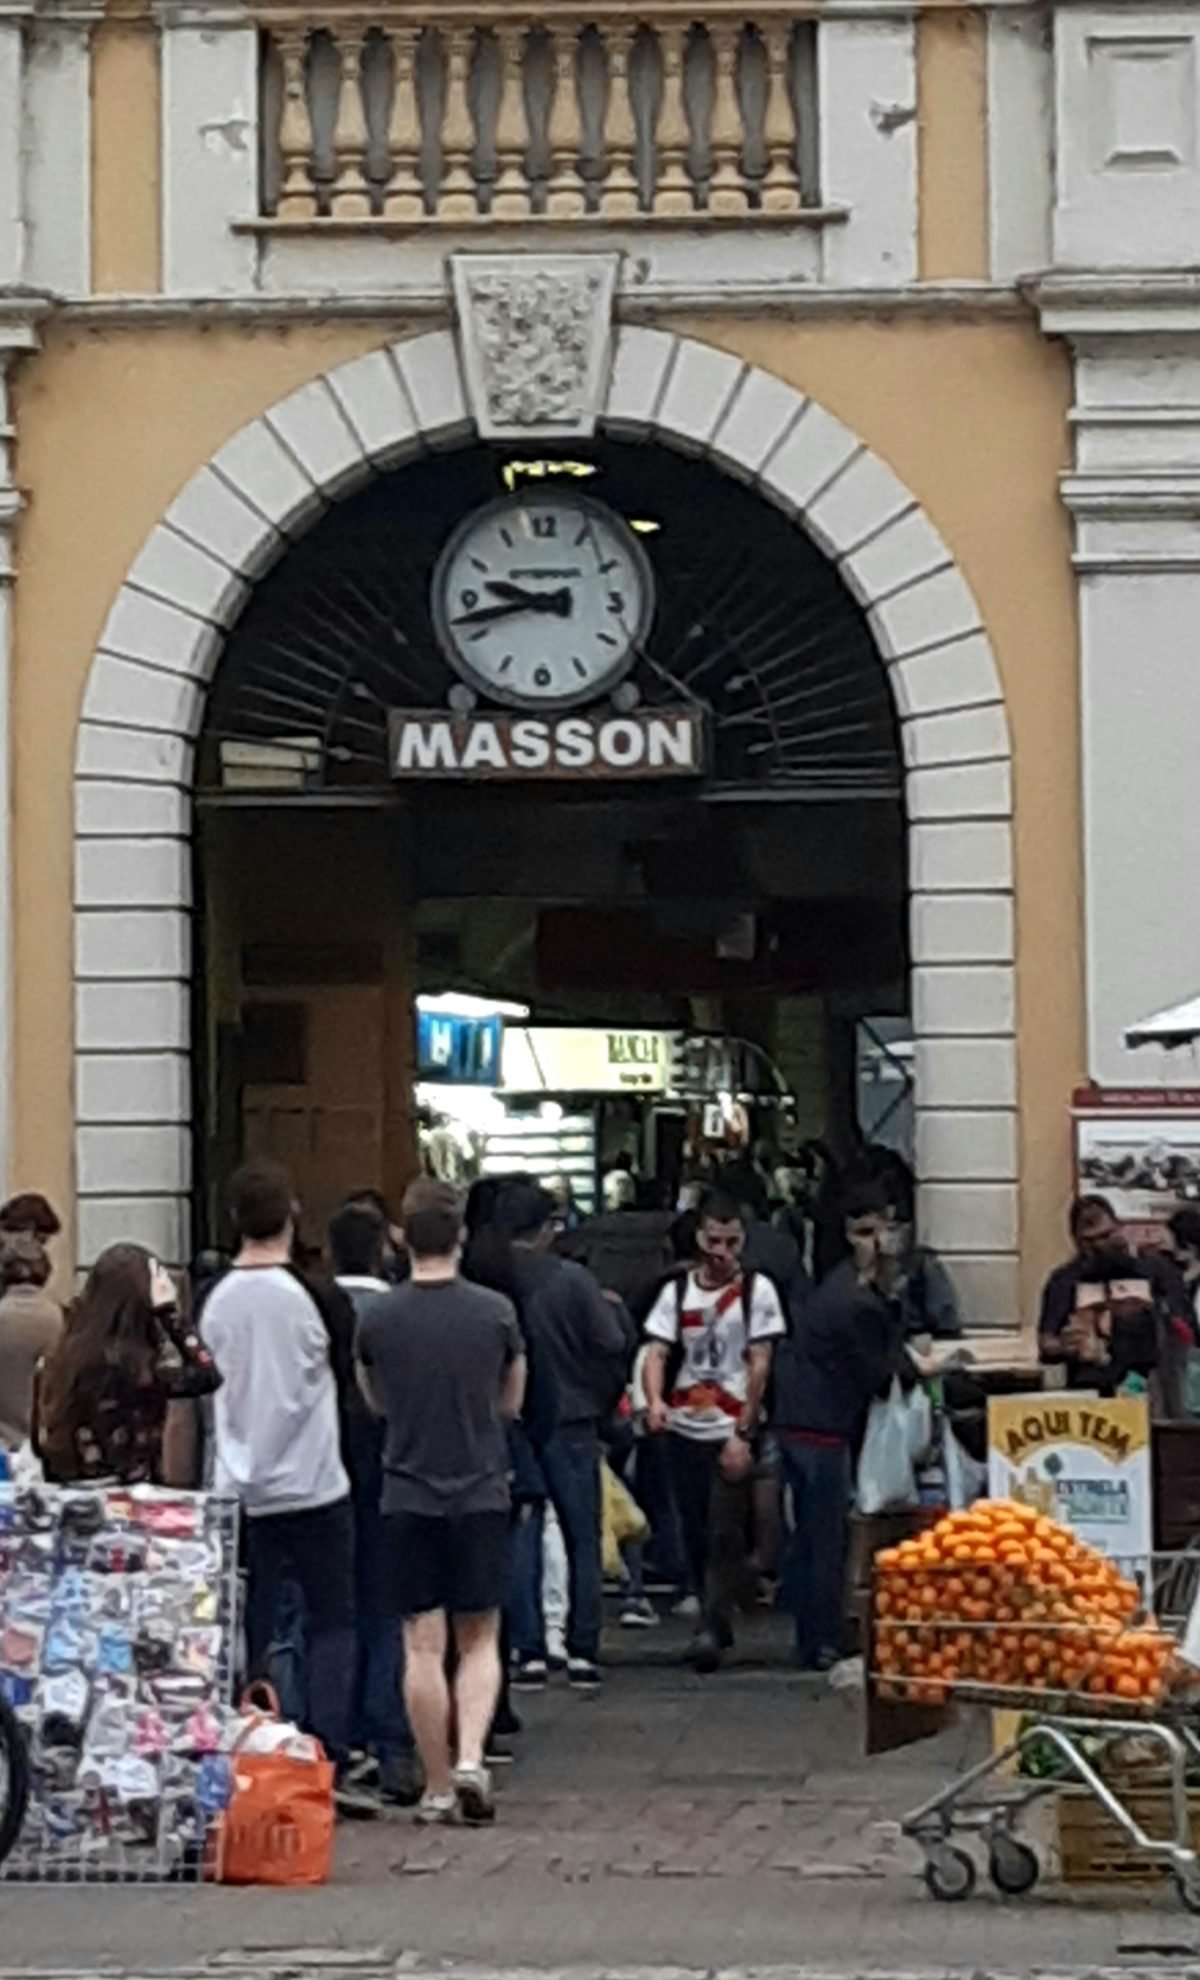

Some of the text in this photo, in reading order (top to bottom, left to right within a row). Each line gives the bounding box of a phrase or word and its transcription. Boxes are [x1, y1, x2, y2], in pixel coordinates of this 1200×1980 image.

[531, 516, 557, 538] 12
[397, 719, 693, 768] MASSON
[1005, 1410, 1131, 1453] AQUI TEM
